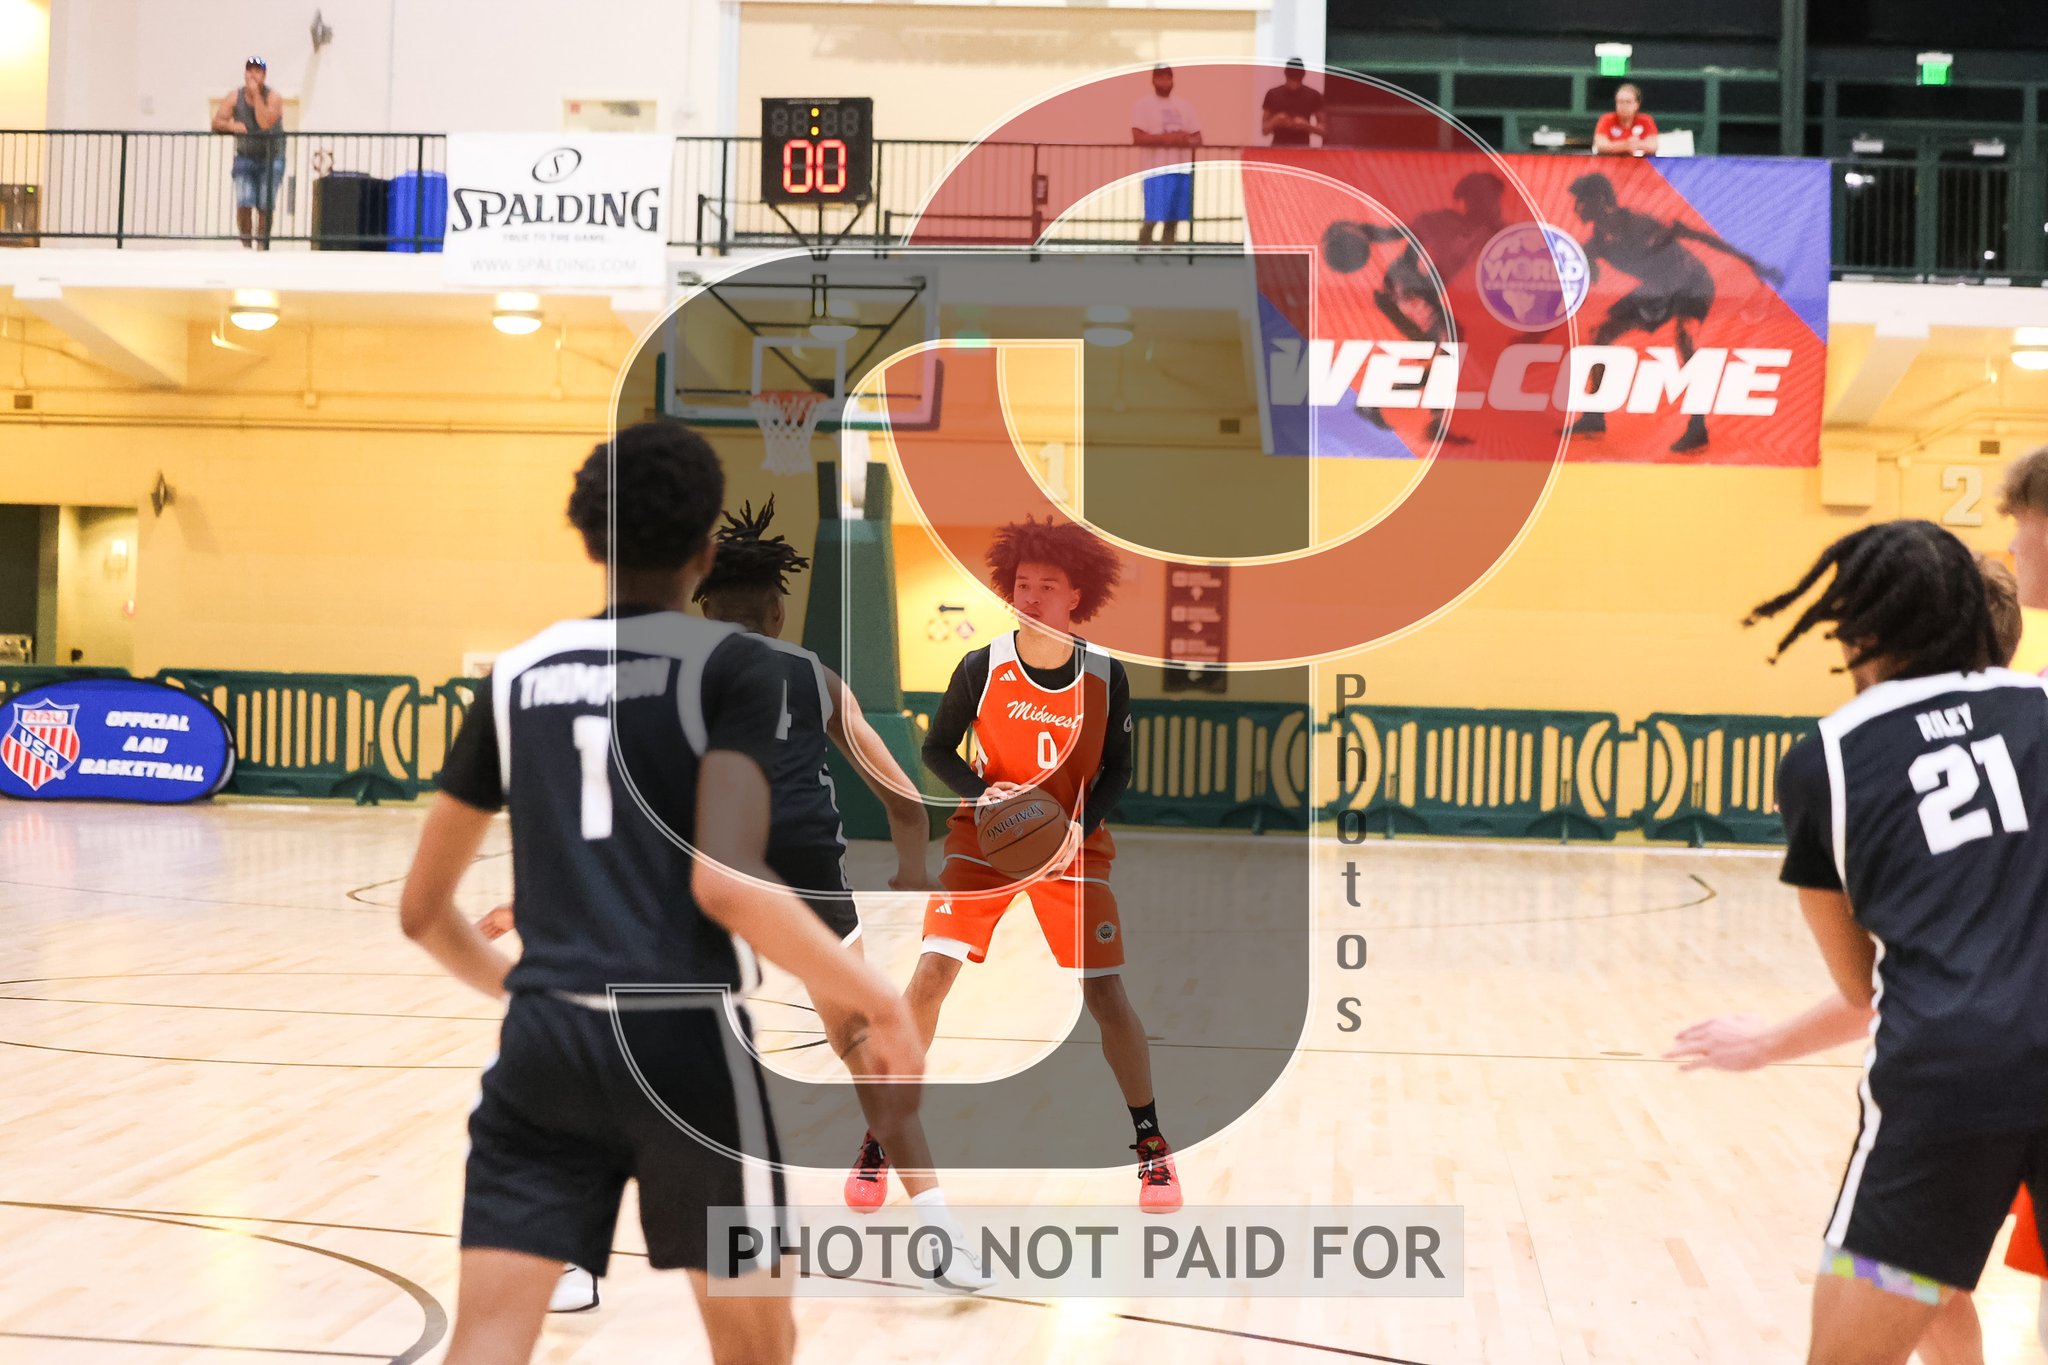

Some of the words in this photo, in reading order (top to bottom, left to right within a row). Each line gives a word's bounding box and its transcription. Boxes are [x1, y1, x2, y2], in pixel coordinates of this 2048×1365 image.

[783, 139, 848, 194] 00
[452, 187, 660, 232] SPALDING
[1483, 257, 1584, 282] WORLD
[1269, 338, 1793, 416] WELCOME
[1942, 464, 1983, 527] 2
[105, 711, 190, 732] OFFICIAL
[1007, 700, 1084, 730] Midwest
[1915, 702, 1974, 742] RILEY
[19, 729, 59, 769] USA
[122, 736, 168, 754] AAU
[1037, 731, 1058, 770] 0
[78, 758, 204, 782] BASKETBALL
[573, 714, 613, 840] 1
[1908, 733, 2029, 856] 21
[987, 802, 1045, 843] SPALDING
